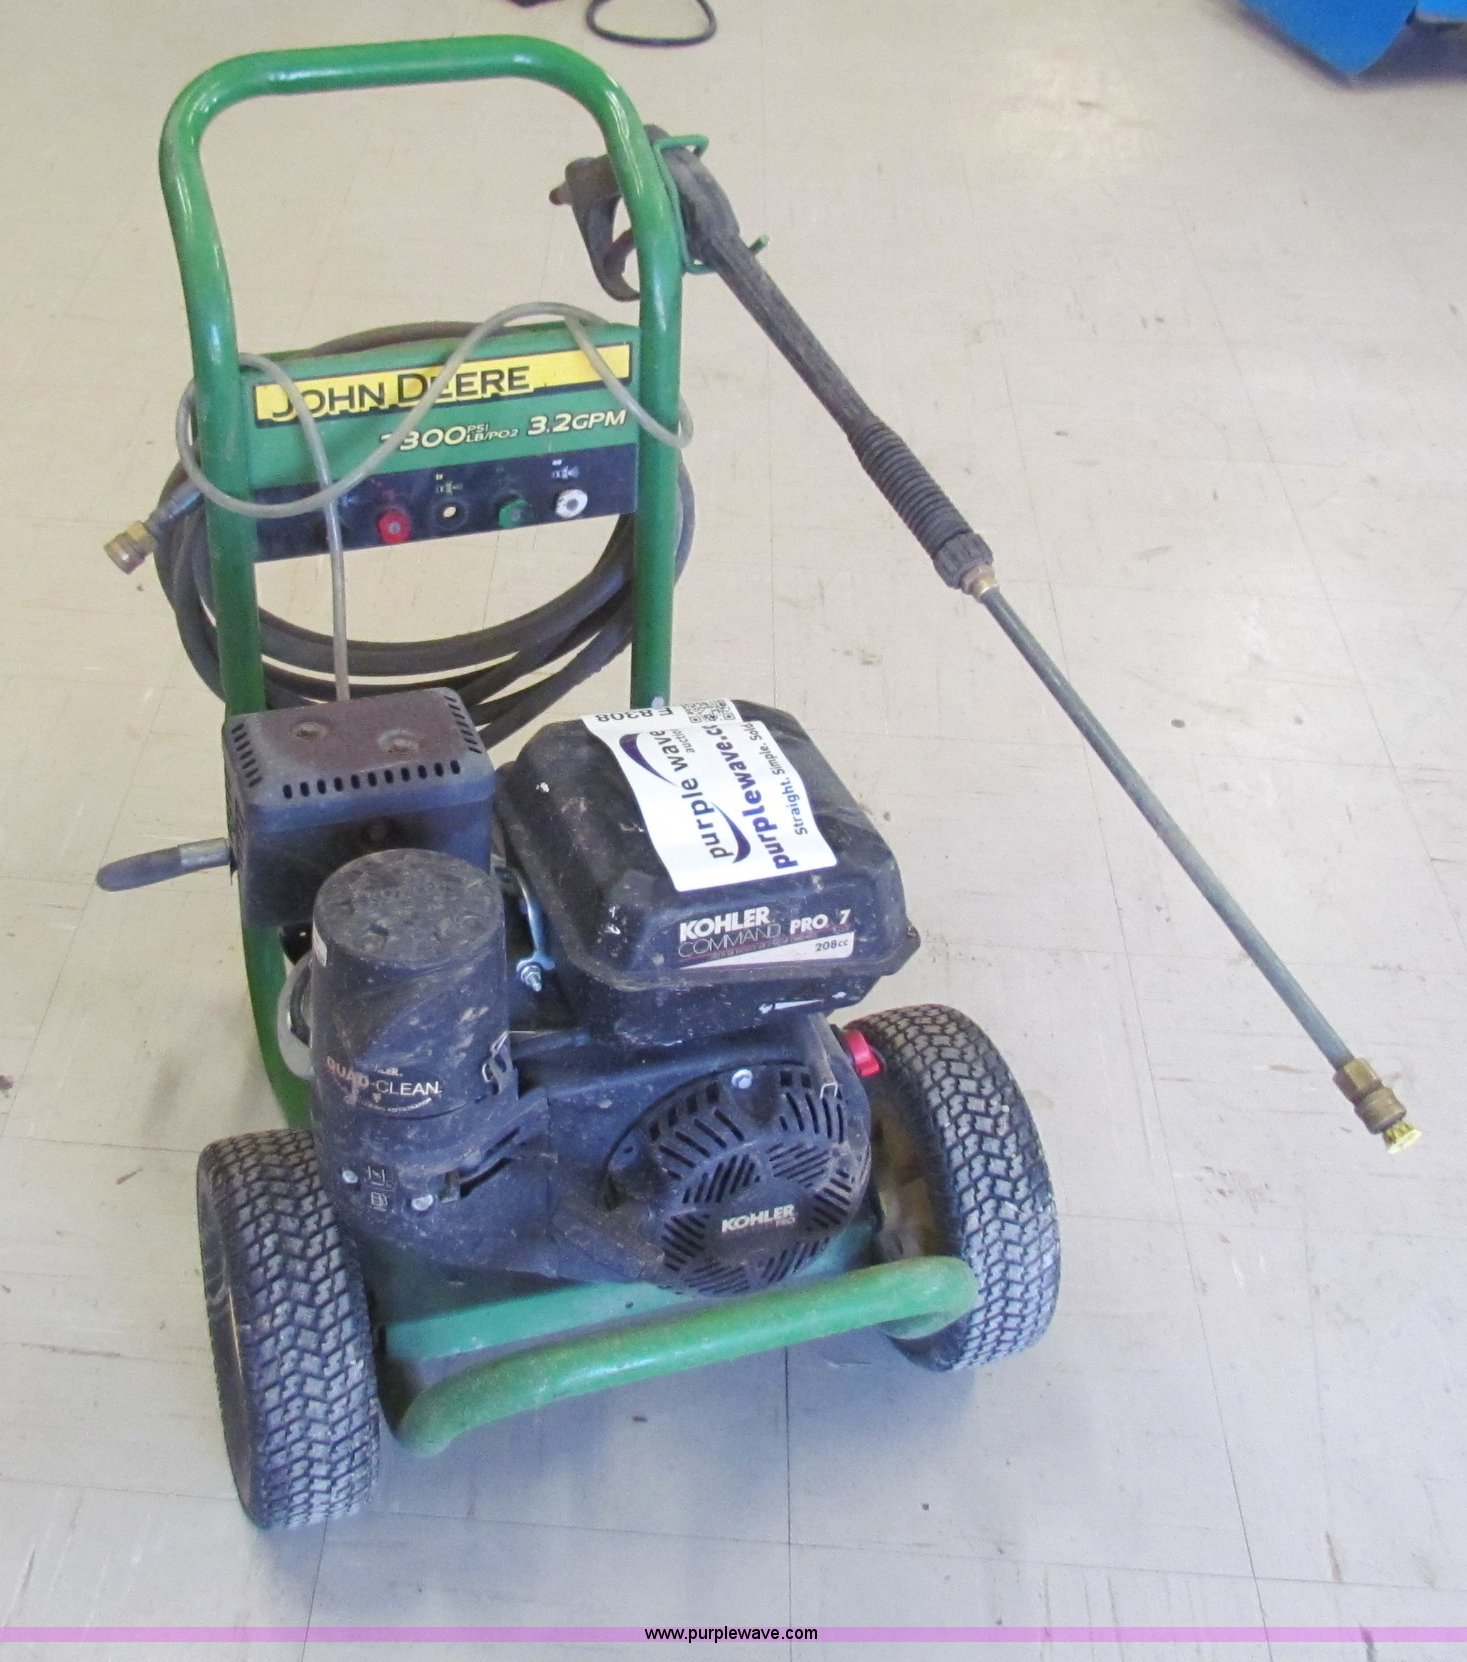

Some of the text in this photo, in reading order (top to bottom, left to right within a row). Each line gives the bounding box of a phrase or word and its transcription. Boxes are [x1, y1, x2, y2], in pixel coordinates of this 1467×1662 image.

[272, 382, 386, 418] JOHN
[381, 409, 627, 451] 300 PSI 3.2GPM
[758, 742, 785, 775] Simple.
[649, 730, 735, 859] purple wave
[780, 777, 809, 836] Straight.
[678, 923, 781, 957] COMMAND
[790, 914, 829, 934] PRO
[839, 909, 851, 925] 7
[679, 906, 770, 942] KOHLER
[814, 938, 849, 952] 208cc
[721, 1203, 795, 1233] KOHLER
